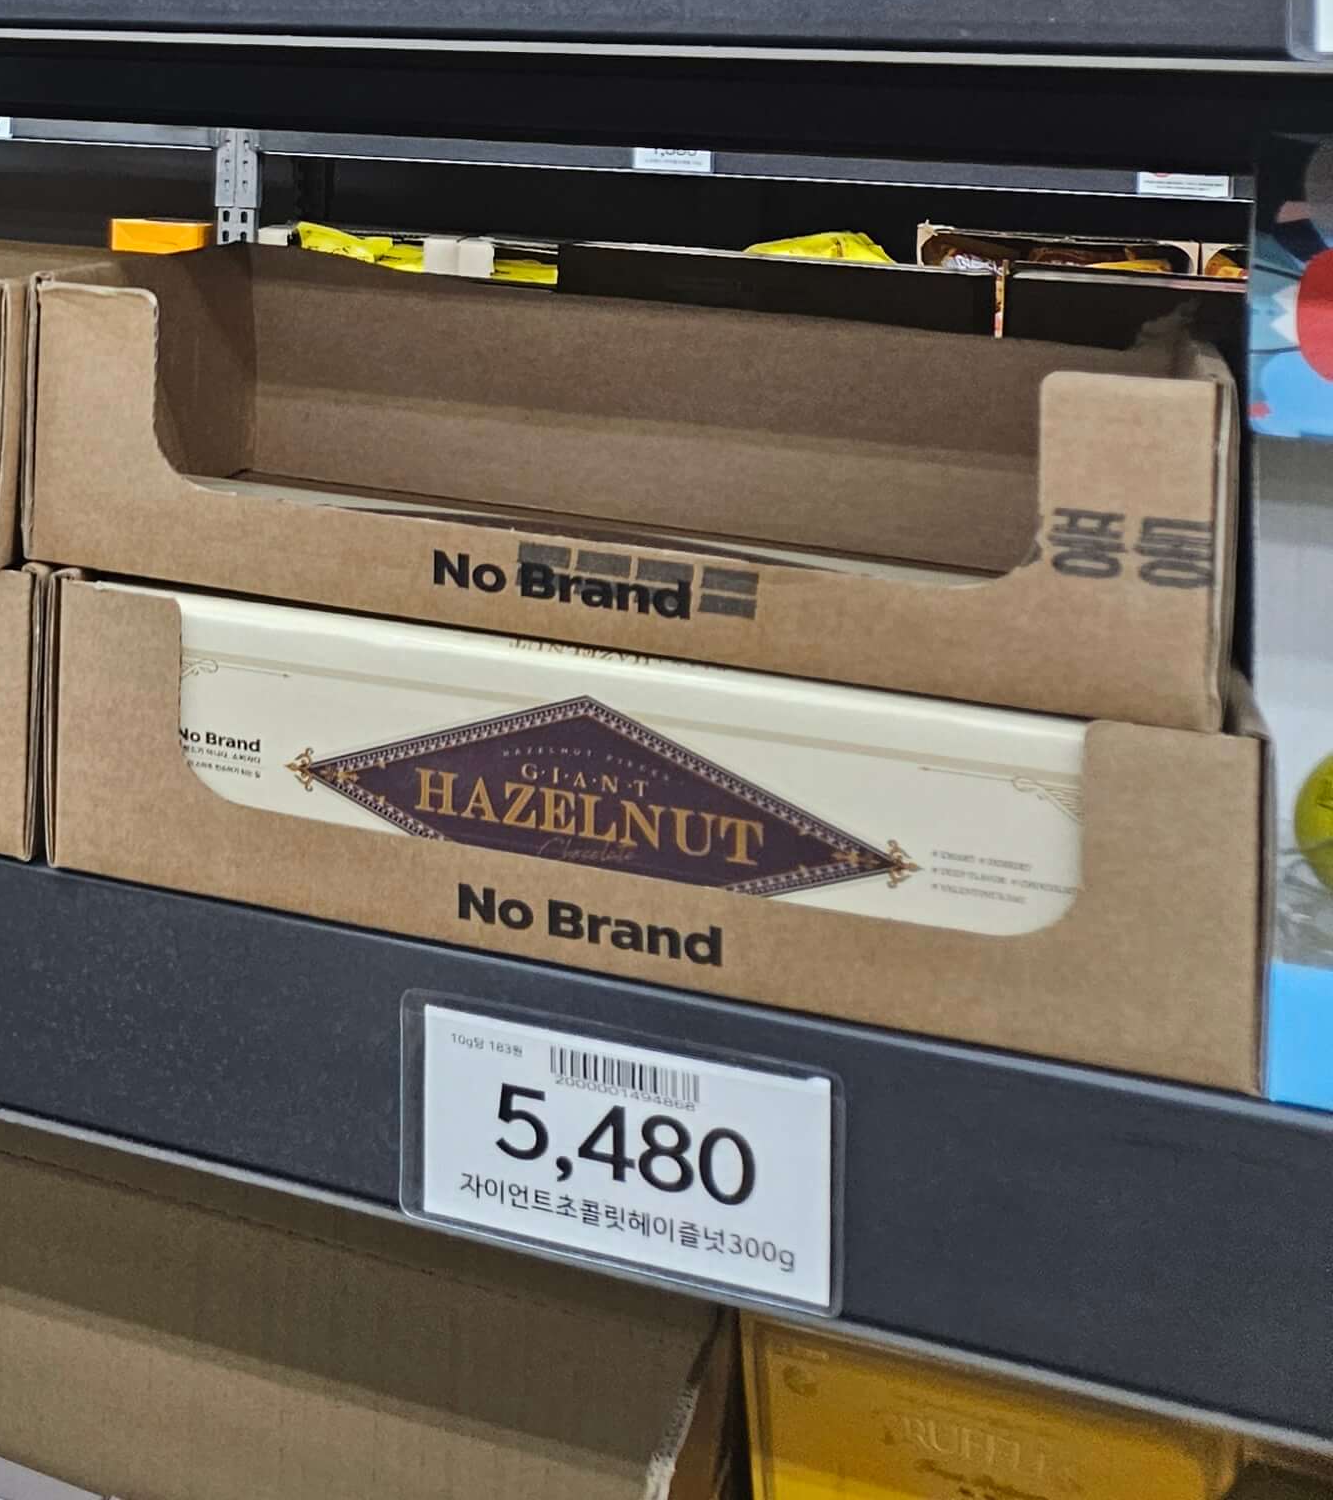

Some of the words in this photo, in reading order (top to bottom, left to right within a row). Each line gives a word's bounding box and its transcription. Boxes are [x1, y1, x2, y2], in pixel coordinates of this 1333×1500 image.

[433, 550, 506, 593] No
[520, 555, 691, 620] Brand
[206, 732, 261, 753] Brand
[415, 765, 765, 866] HAZELNUT
[495, 1083, 756, 1206] 5,480
[460, 1172, 795, 1273] 자이언트초콜릿헤이즐넛300g
